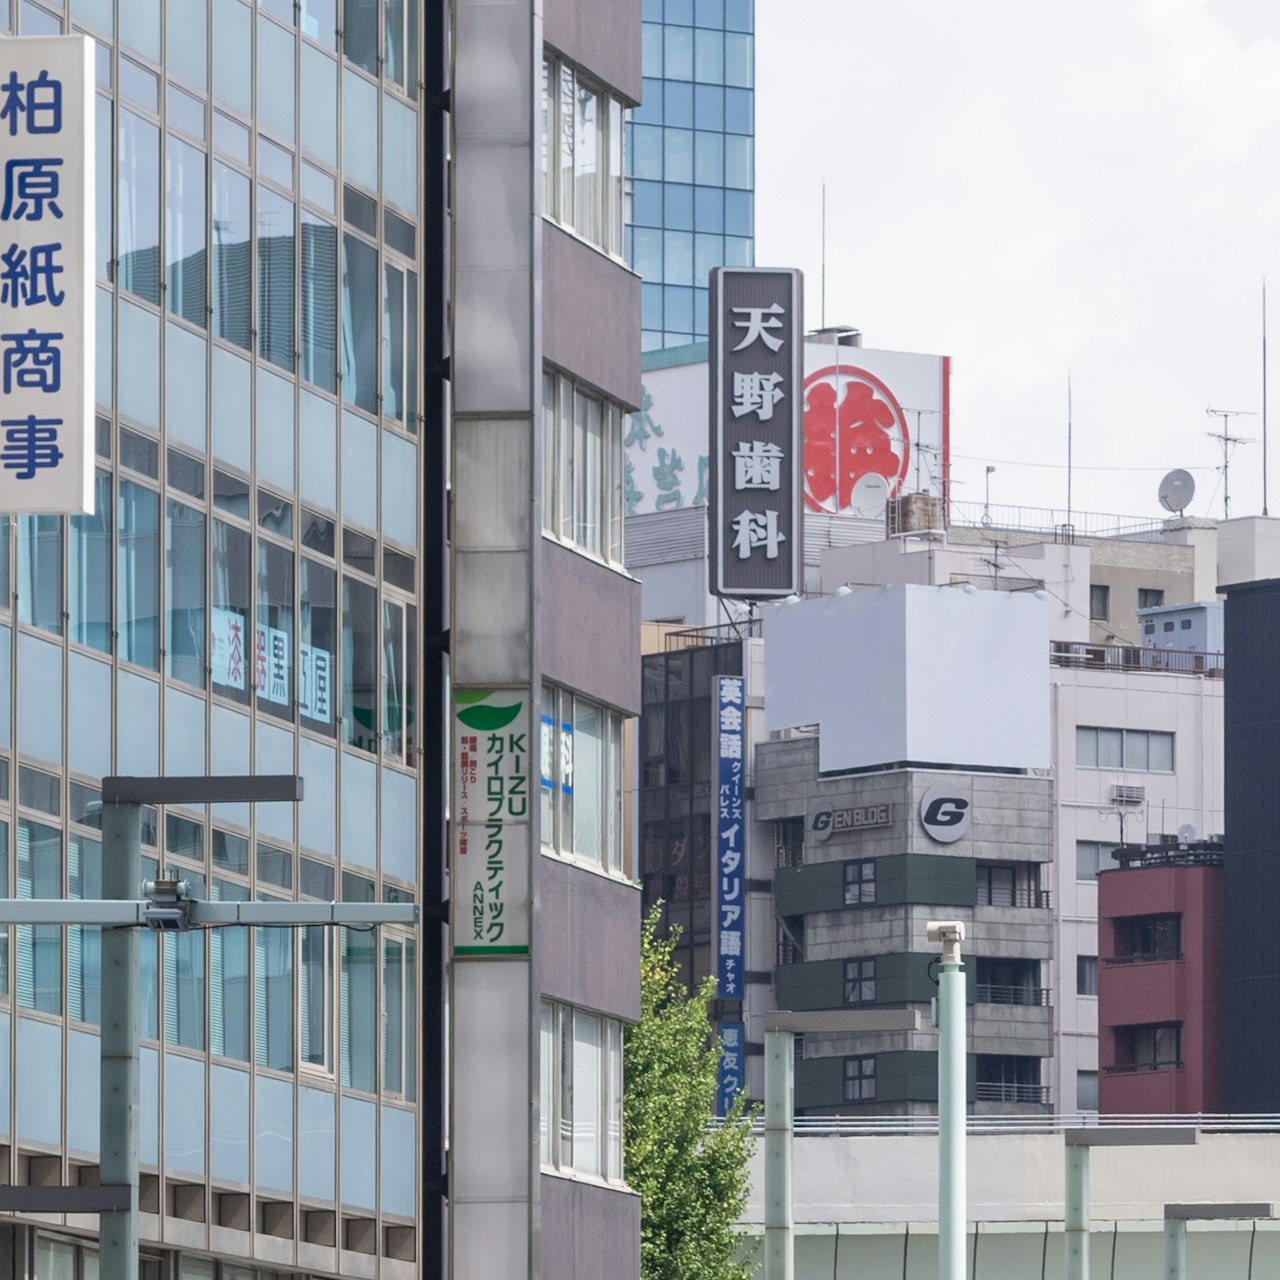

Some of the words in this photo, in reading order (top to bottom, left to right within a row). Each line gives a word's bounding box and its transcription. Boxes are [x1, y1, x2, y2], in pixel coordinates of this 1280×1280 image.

[0, 69, 65, 480] 柏原紙商事
[731, 303, 786, 561] 天野歯科
[720, 679, 742, 760] 英会話
[509, 734, 527, 817] KIZU
[473, 881, 484, 940] ANNEX
[720, 823, 741, 956] イタリア語
[725, 958, 736, 993] チャオ
